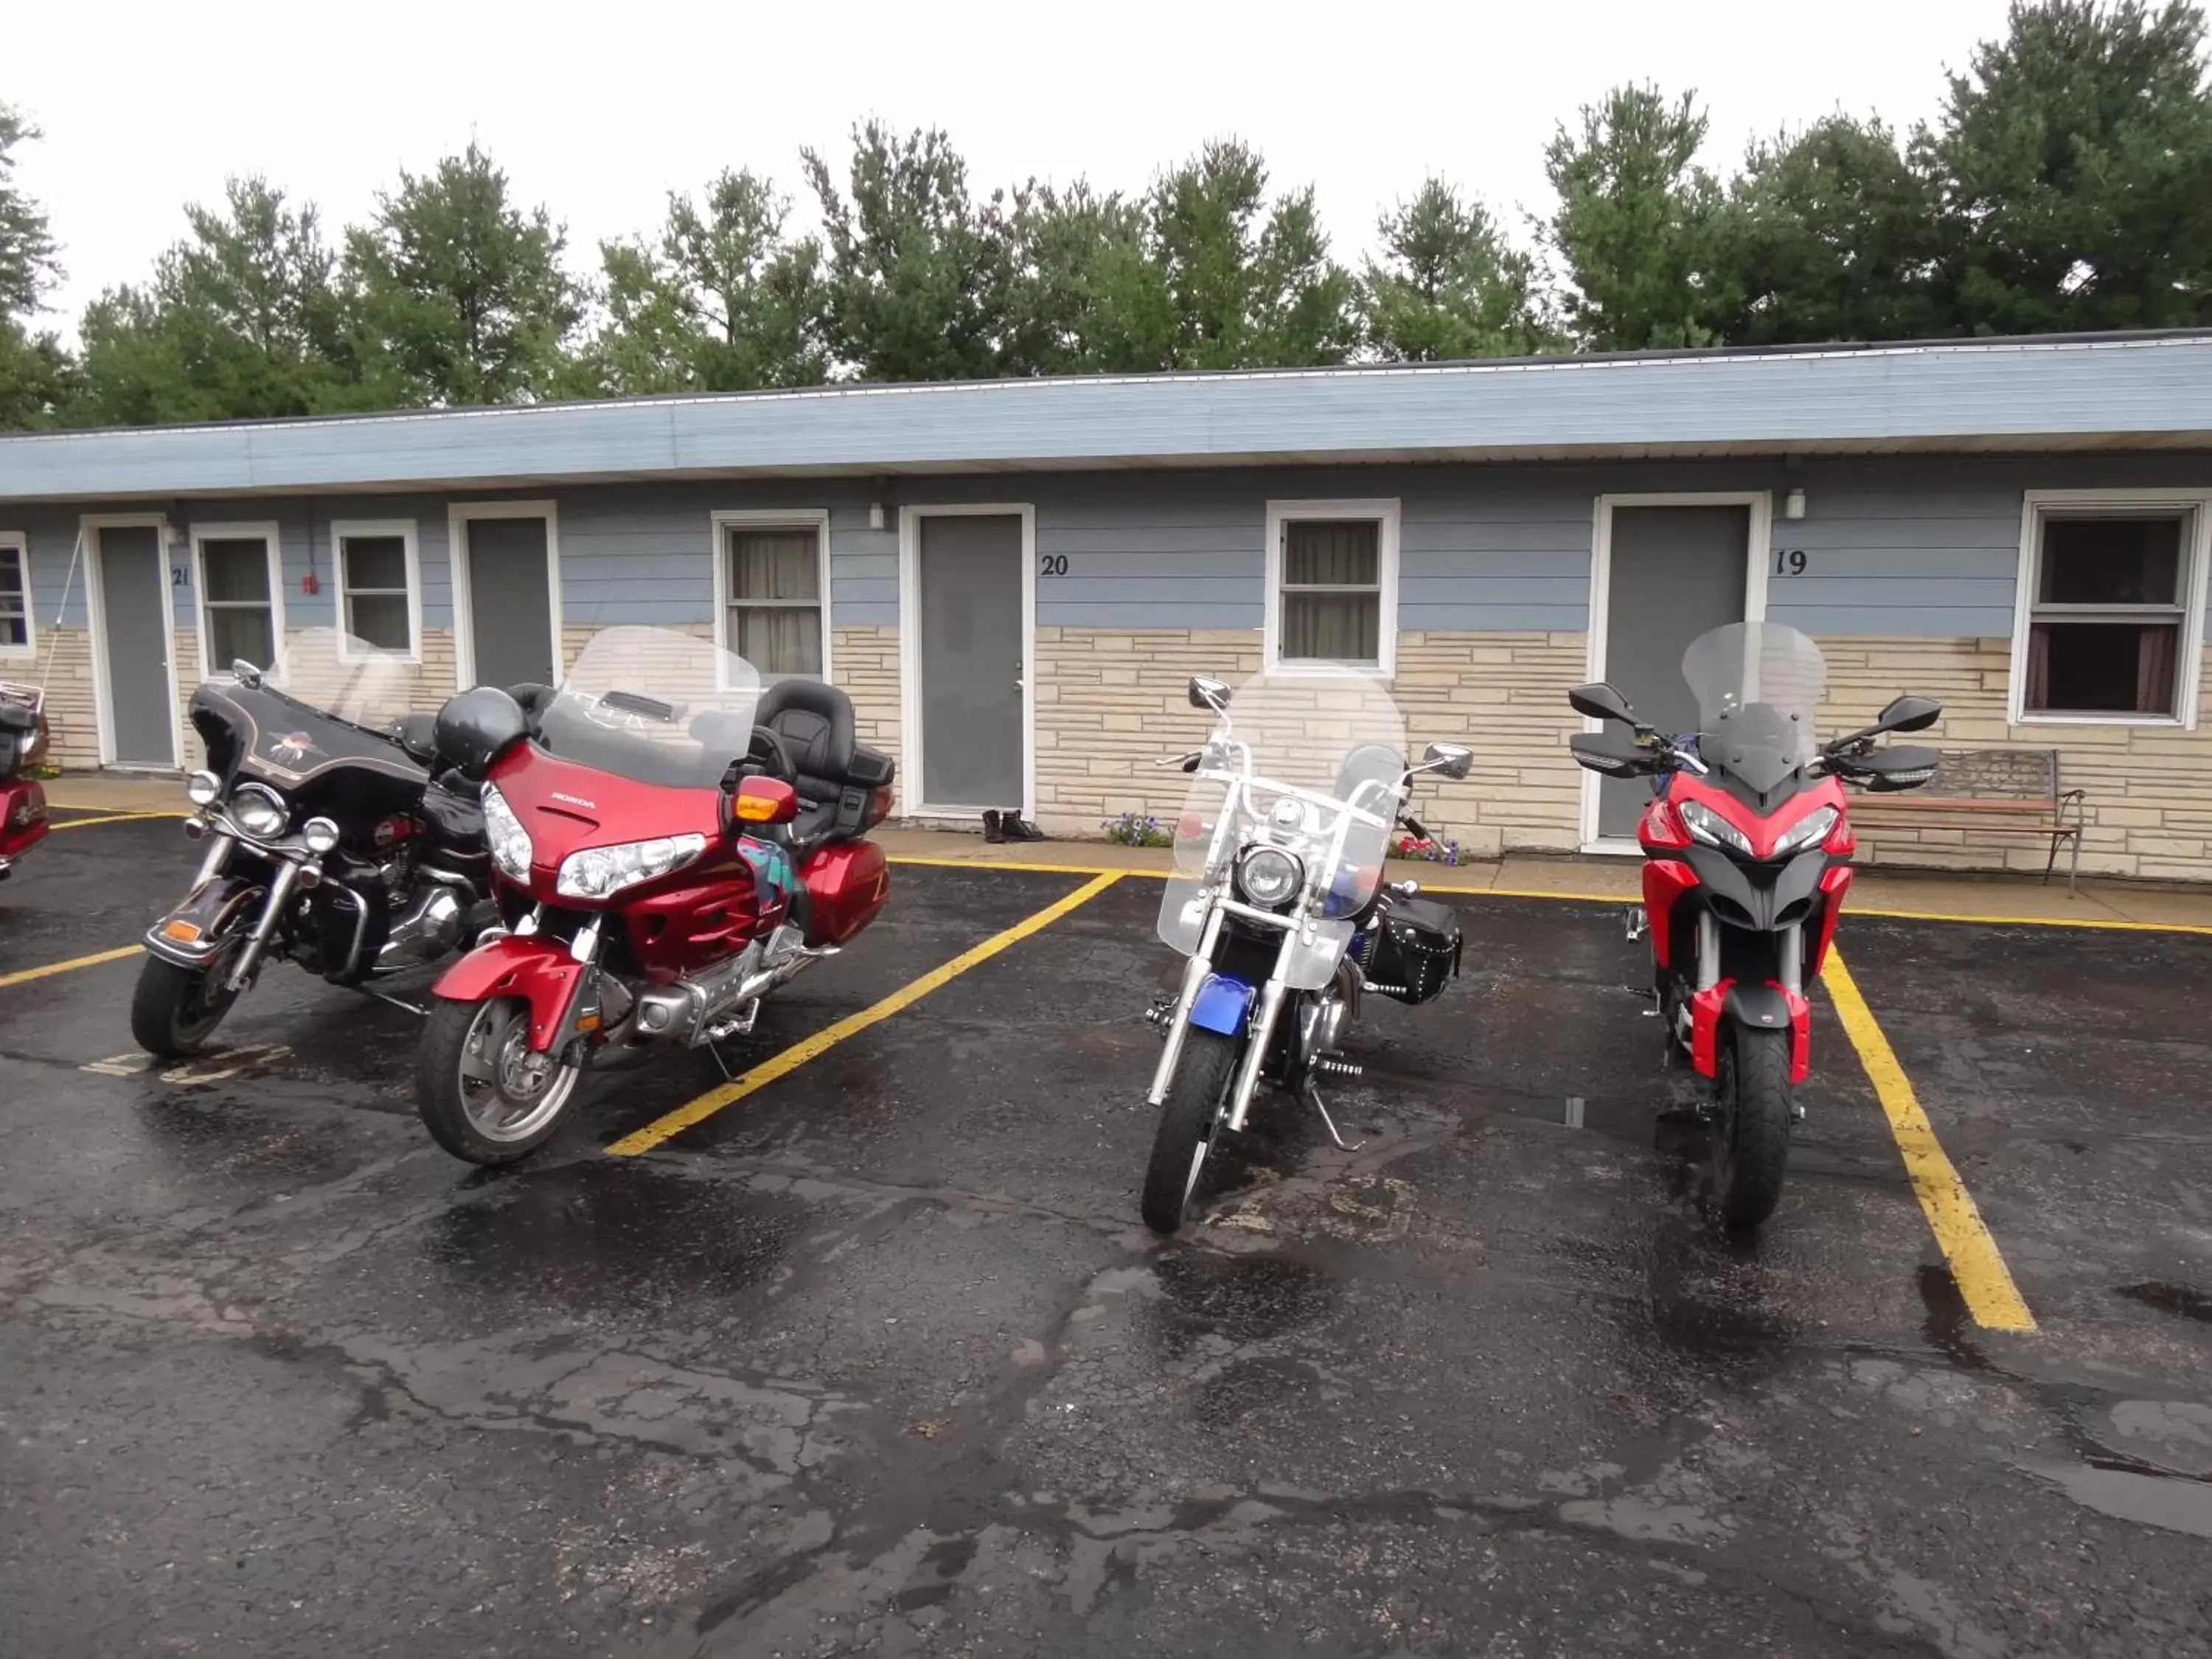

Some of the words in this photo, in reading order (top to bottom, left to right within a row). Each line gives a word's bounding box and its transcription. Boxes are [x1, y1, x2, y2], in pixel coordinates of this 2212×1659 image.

[1040, 555, 1068, 575] 20
[1778, 550, 1806, 575] 19
[173, 568, 188, 585] 21
[551, 792, 596, 809] HONDA
